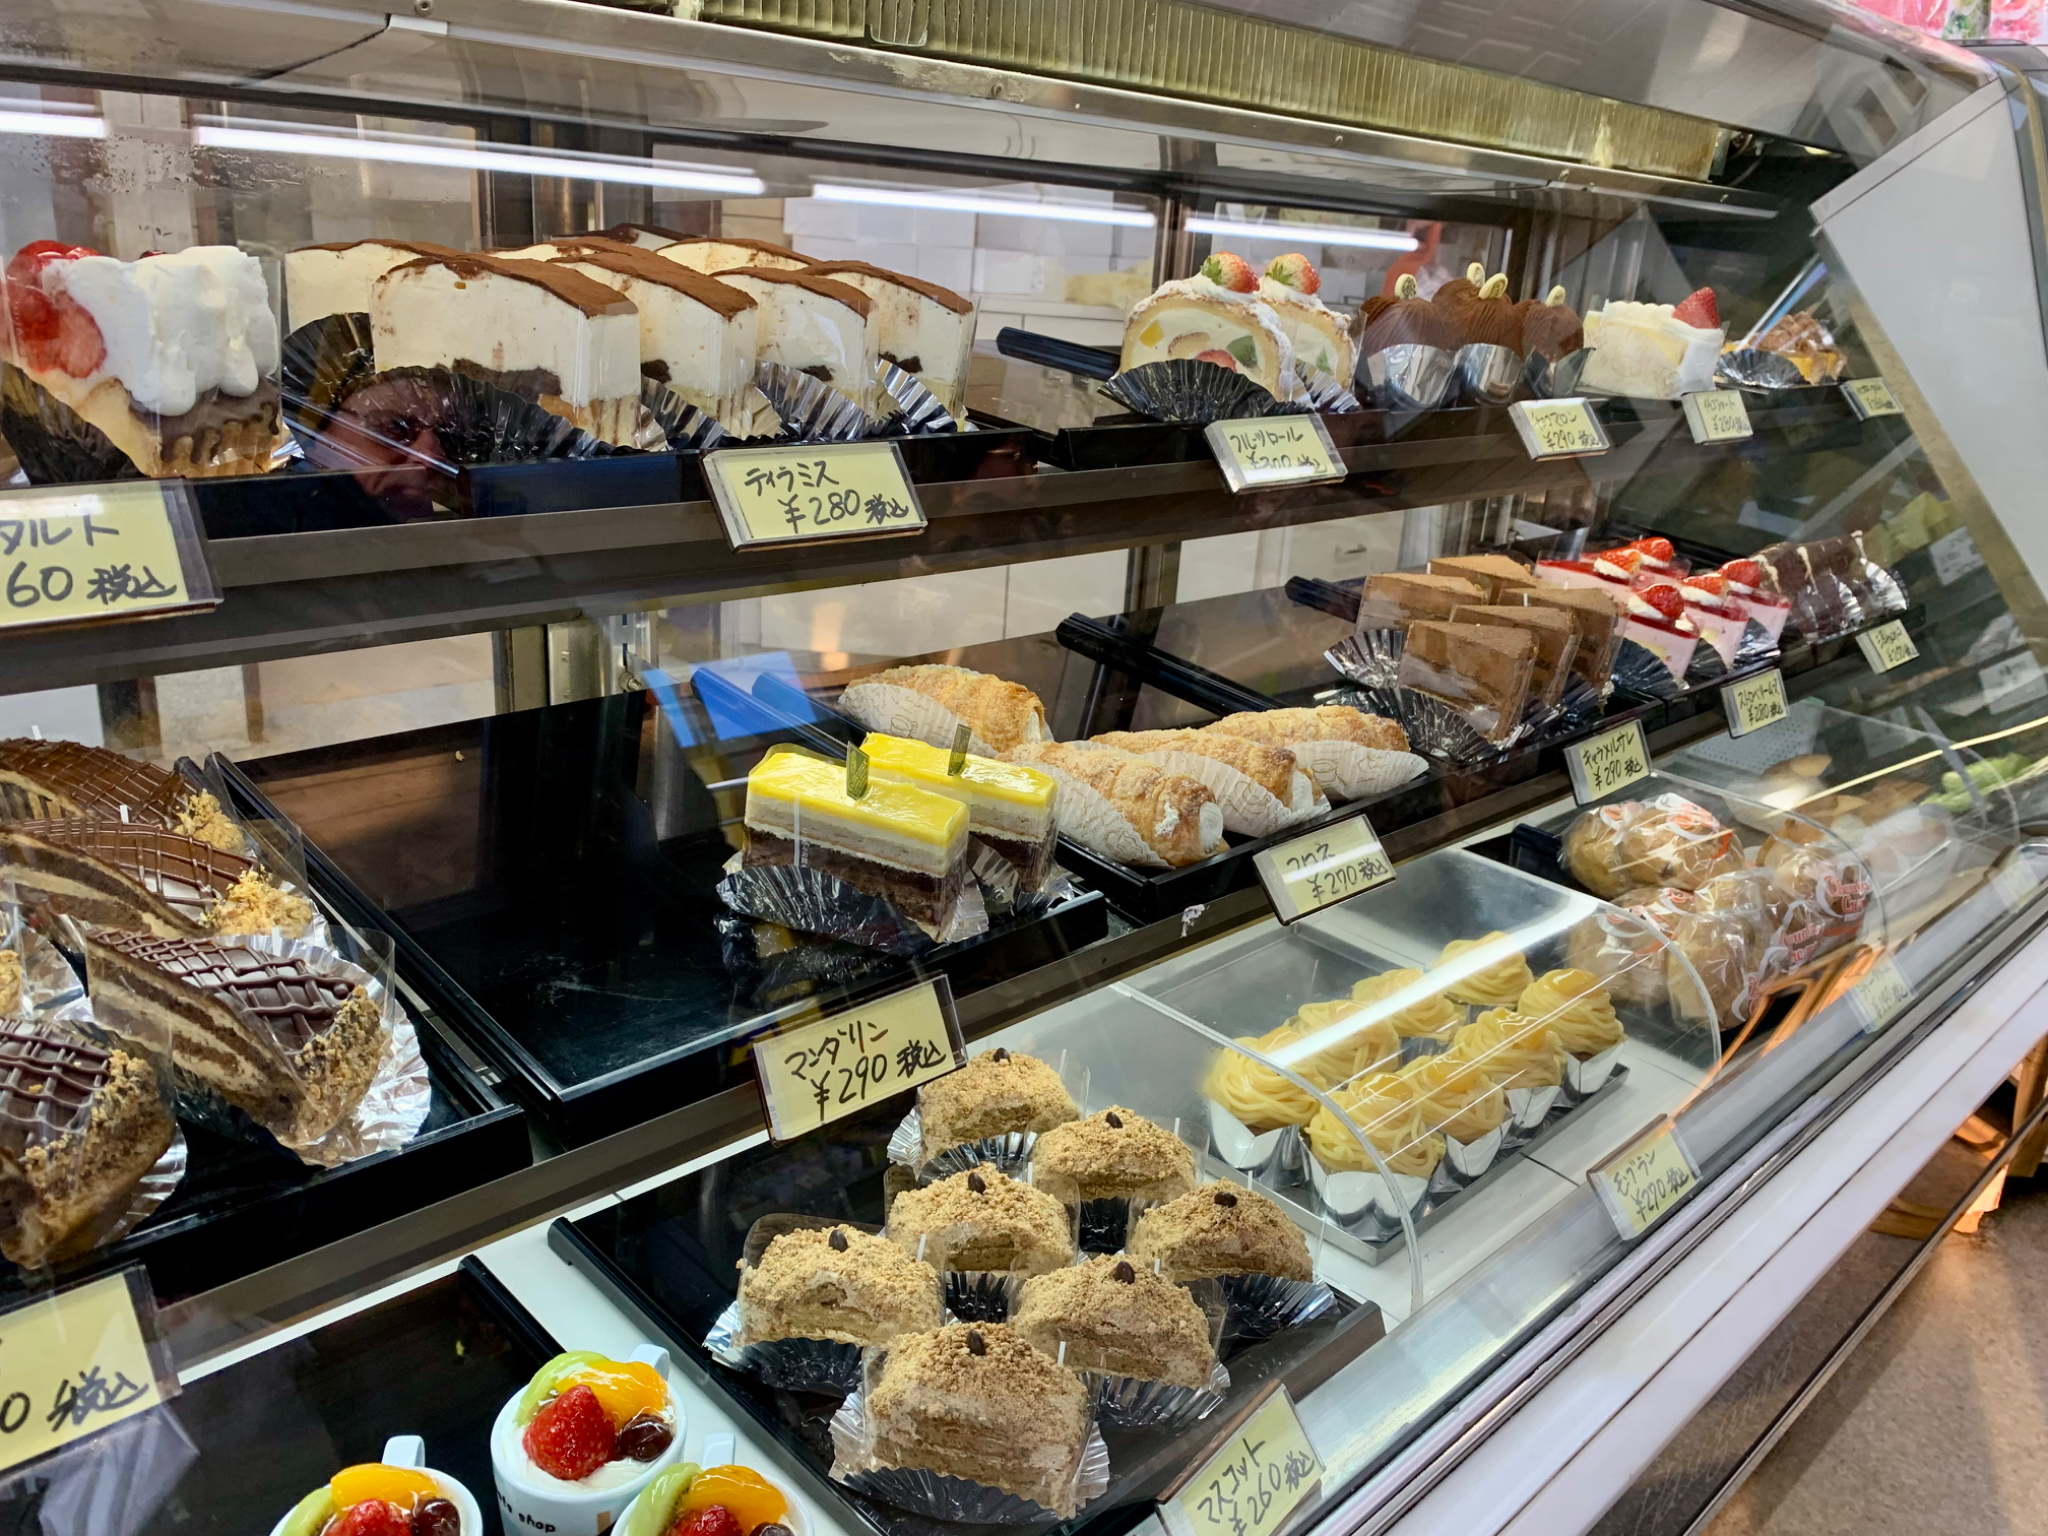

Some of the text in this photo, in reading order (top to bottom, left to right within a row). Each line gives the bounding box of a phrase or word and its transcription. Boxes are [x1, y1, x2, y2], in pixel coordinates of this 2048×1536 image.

[1230, 426, 1304, 453] フルーツロール
[1543, 429, 1576, 452] ¥290
[744, 460, 839, 497] ティラミス
[777, 489, 909, 534] ¥280 税込
[86, 564, 177, 605] 税込
[1582, 731, 1635, 769] キャラメルサレ
[1593, 759, 1621, 792] ¥290
[1306, 857, 1389, 905] ¥270 税込
[785, 1020, 888, 1080] マンダリン
[810, 1040, 946, 1121] ¥290 税込
[1613, 1149, 1656, 1197] モンブラン
[1630, 1166, 1689, 1223] ¥270 税込
[46, 1366, 149, 1432] 税込
[1197, 1438, 1266, 1524] マスコット
[1228, 1451, 1315, 1536] ¥260 税込
[518, 1512, 556, 1533] shop
